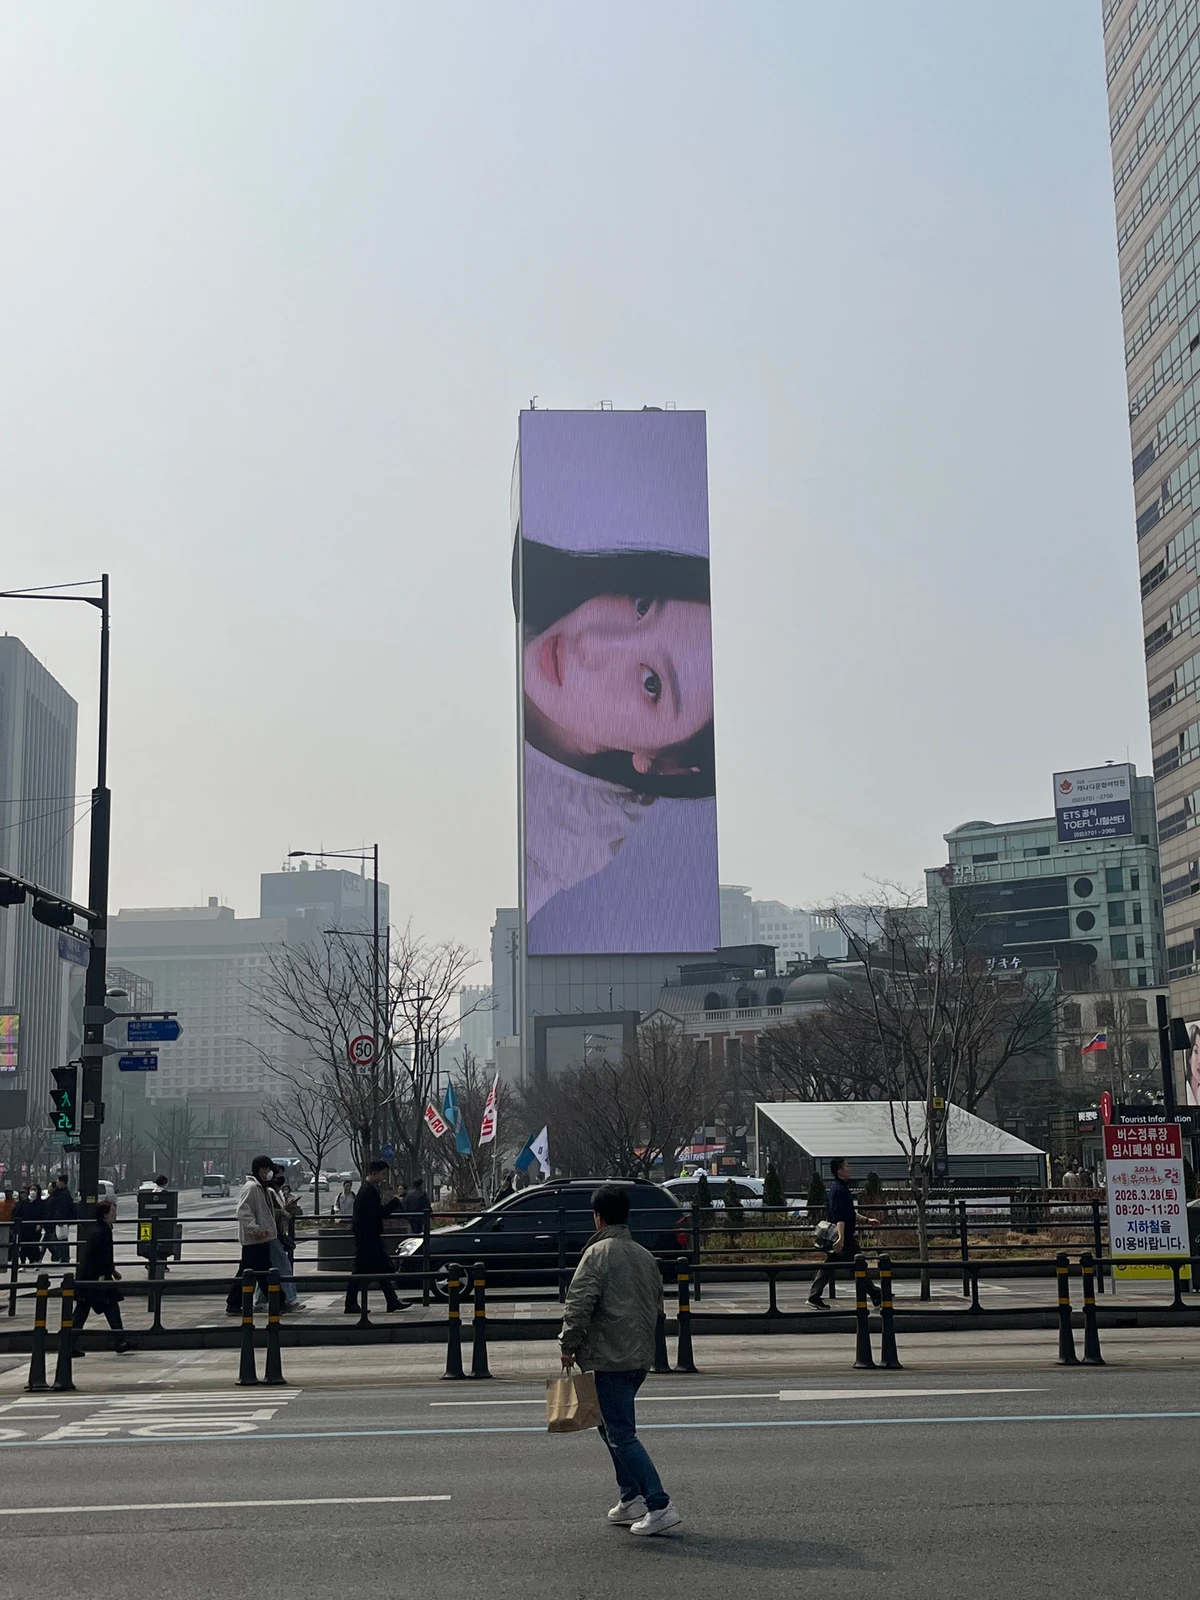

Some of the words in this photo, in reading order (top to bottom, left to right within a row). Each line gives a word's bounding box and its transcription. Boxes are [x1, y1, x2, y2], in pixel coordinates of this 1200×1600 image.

[1063, 811, 1081, 820] ETS
[1082, 808, 1097, 818] 공식
[1064, 820, 1093, 830] TOEFL
[1094, 815, 1125, 826] 시험센터
[952, 863, 975, 877] 치과
[355, 1043, 372, 1057] 50
[1120, 1115, 1146, 1123] Tourist
[1147, 1115, 1192, 1123] Infortion
[1117, 1127, 1168, 1141] 버스정류장
[1112, 1143, 1153, 1157] 임시폐쇄
[1155, 1143, 1175, 1157] 안내
[1112, 1173, 1128, 1184] 서울
[1130, 1174, 1163, 1184] 유아차
[1164, 1168, 1179, 1184] 런
[1115, 1188, 1178, 1201] 2026.3.28(토)
[1115, 1204, 1180, 1215] 08:20~11:20
[1127, 1220, 1171, 1234] 지하철을
[1115, 1237, 1185, 1251] 이용바랍니다.
